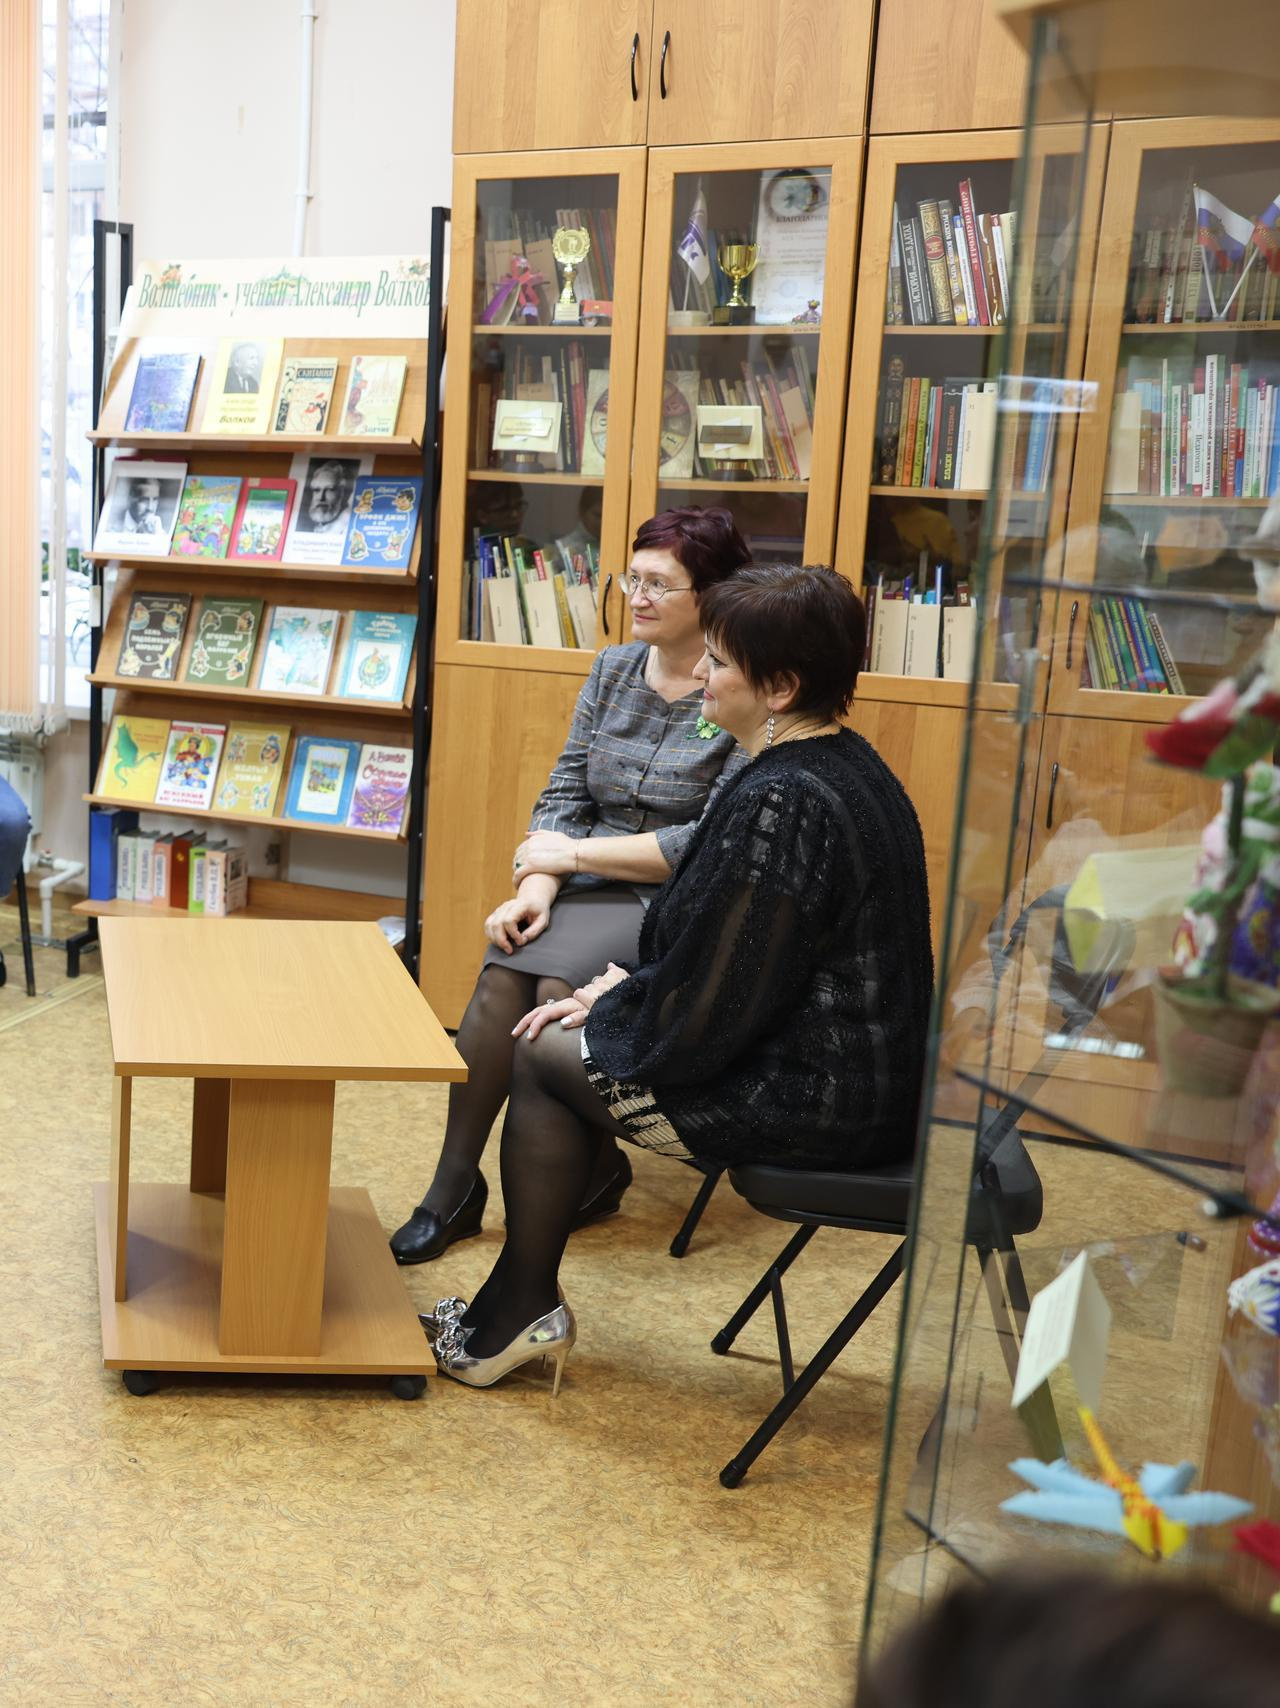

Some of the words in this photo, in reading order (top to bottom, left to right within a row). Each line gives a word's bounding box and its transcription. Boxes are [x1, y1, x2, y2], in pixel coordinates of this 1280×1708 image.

[138, 273, 221, 308] Волшебник
[291, 280, 372, 317] Александр
[373, 270, 431, 308] Волков
[219, 415, 256, 424] Волков
